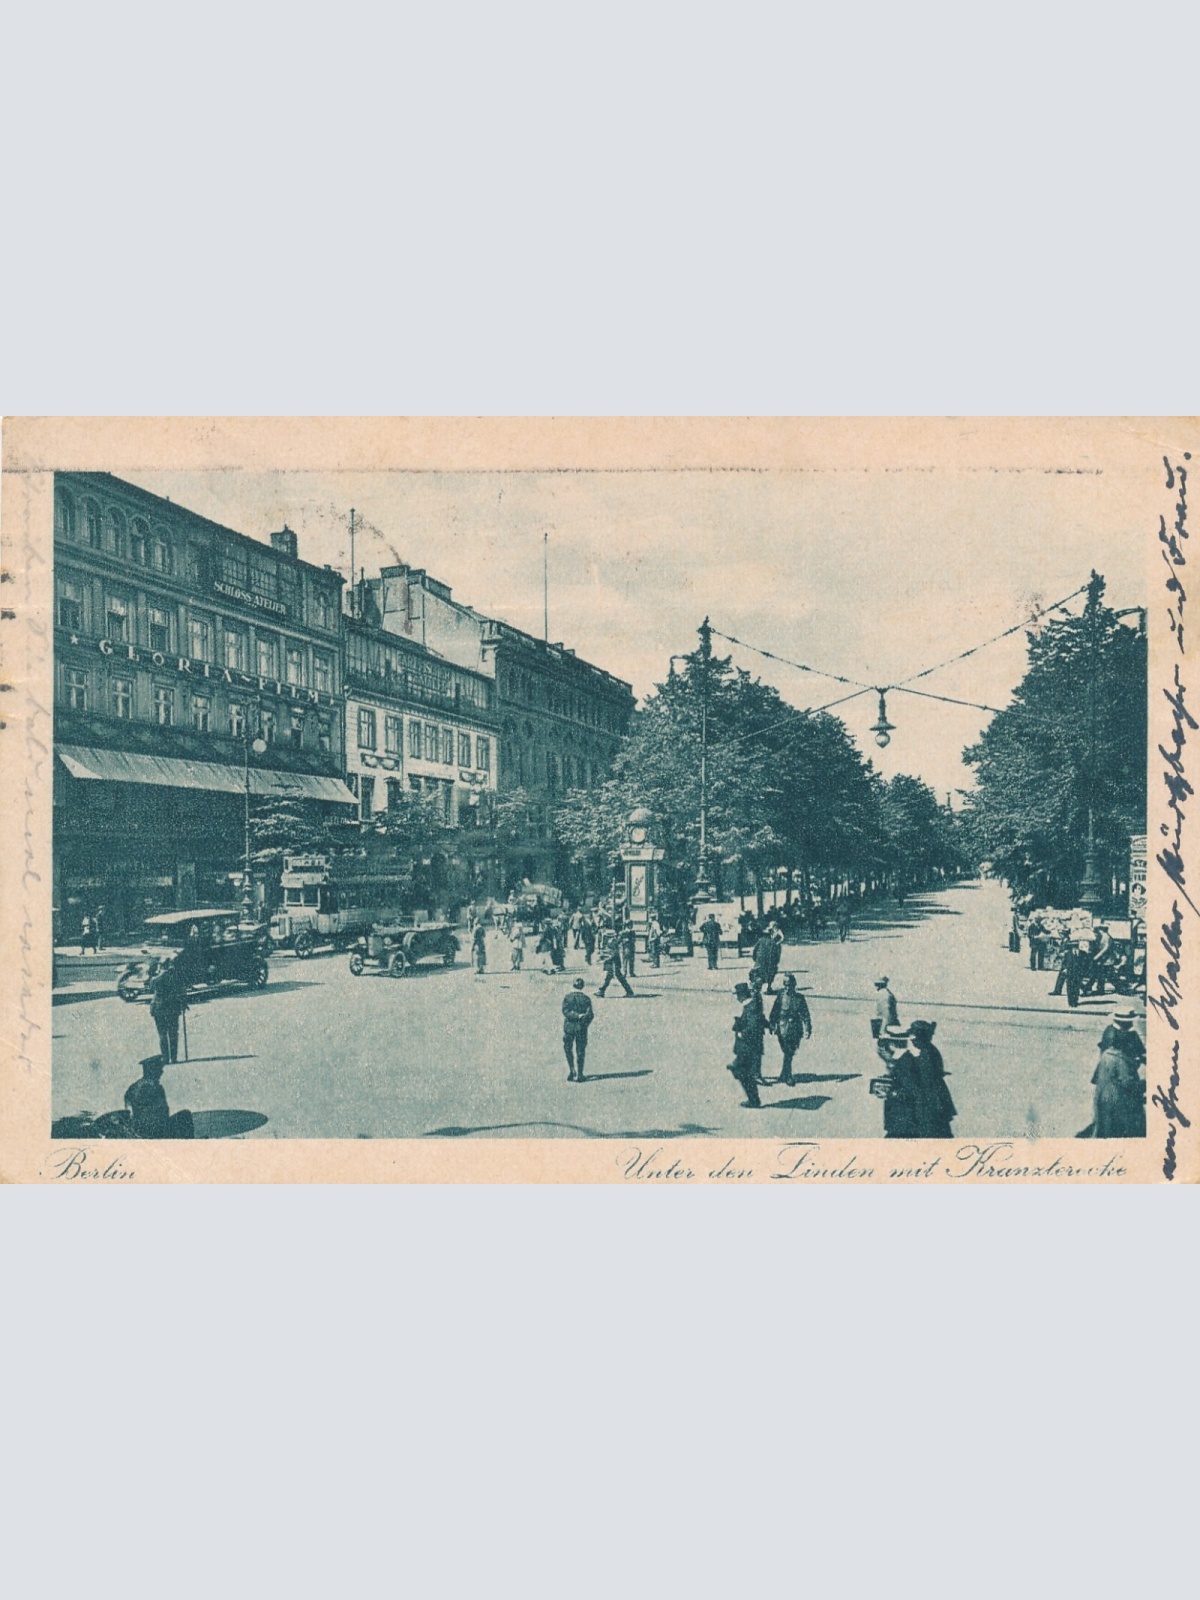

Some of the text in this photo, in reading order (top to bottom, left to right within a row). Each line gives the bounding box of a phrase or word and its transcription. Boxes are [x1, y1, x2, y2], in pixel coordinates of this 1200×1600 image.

[39, 1144, 135, 1180] Berlin
[615, 1146, 696, 1180] Unter
[708, 1156, 753, 1179] den
[769, 1141, 875, 1179] Linden
[889, 1157, 942, 1178] mit
